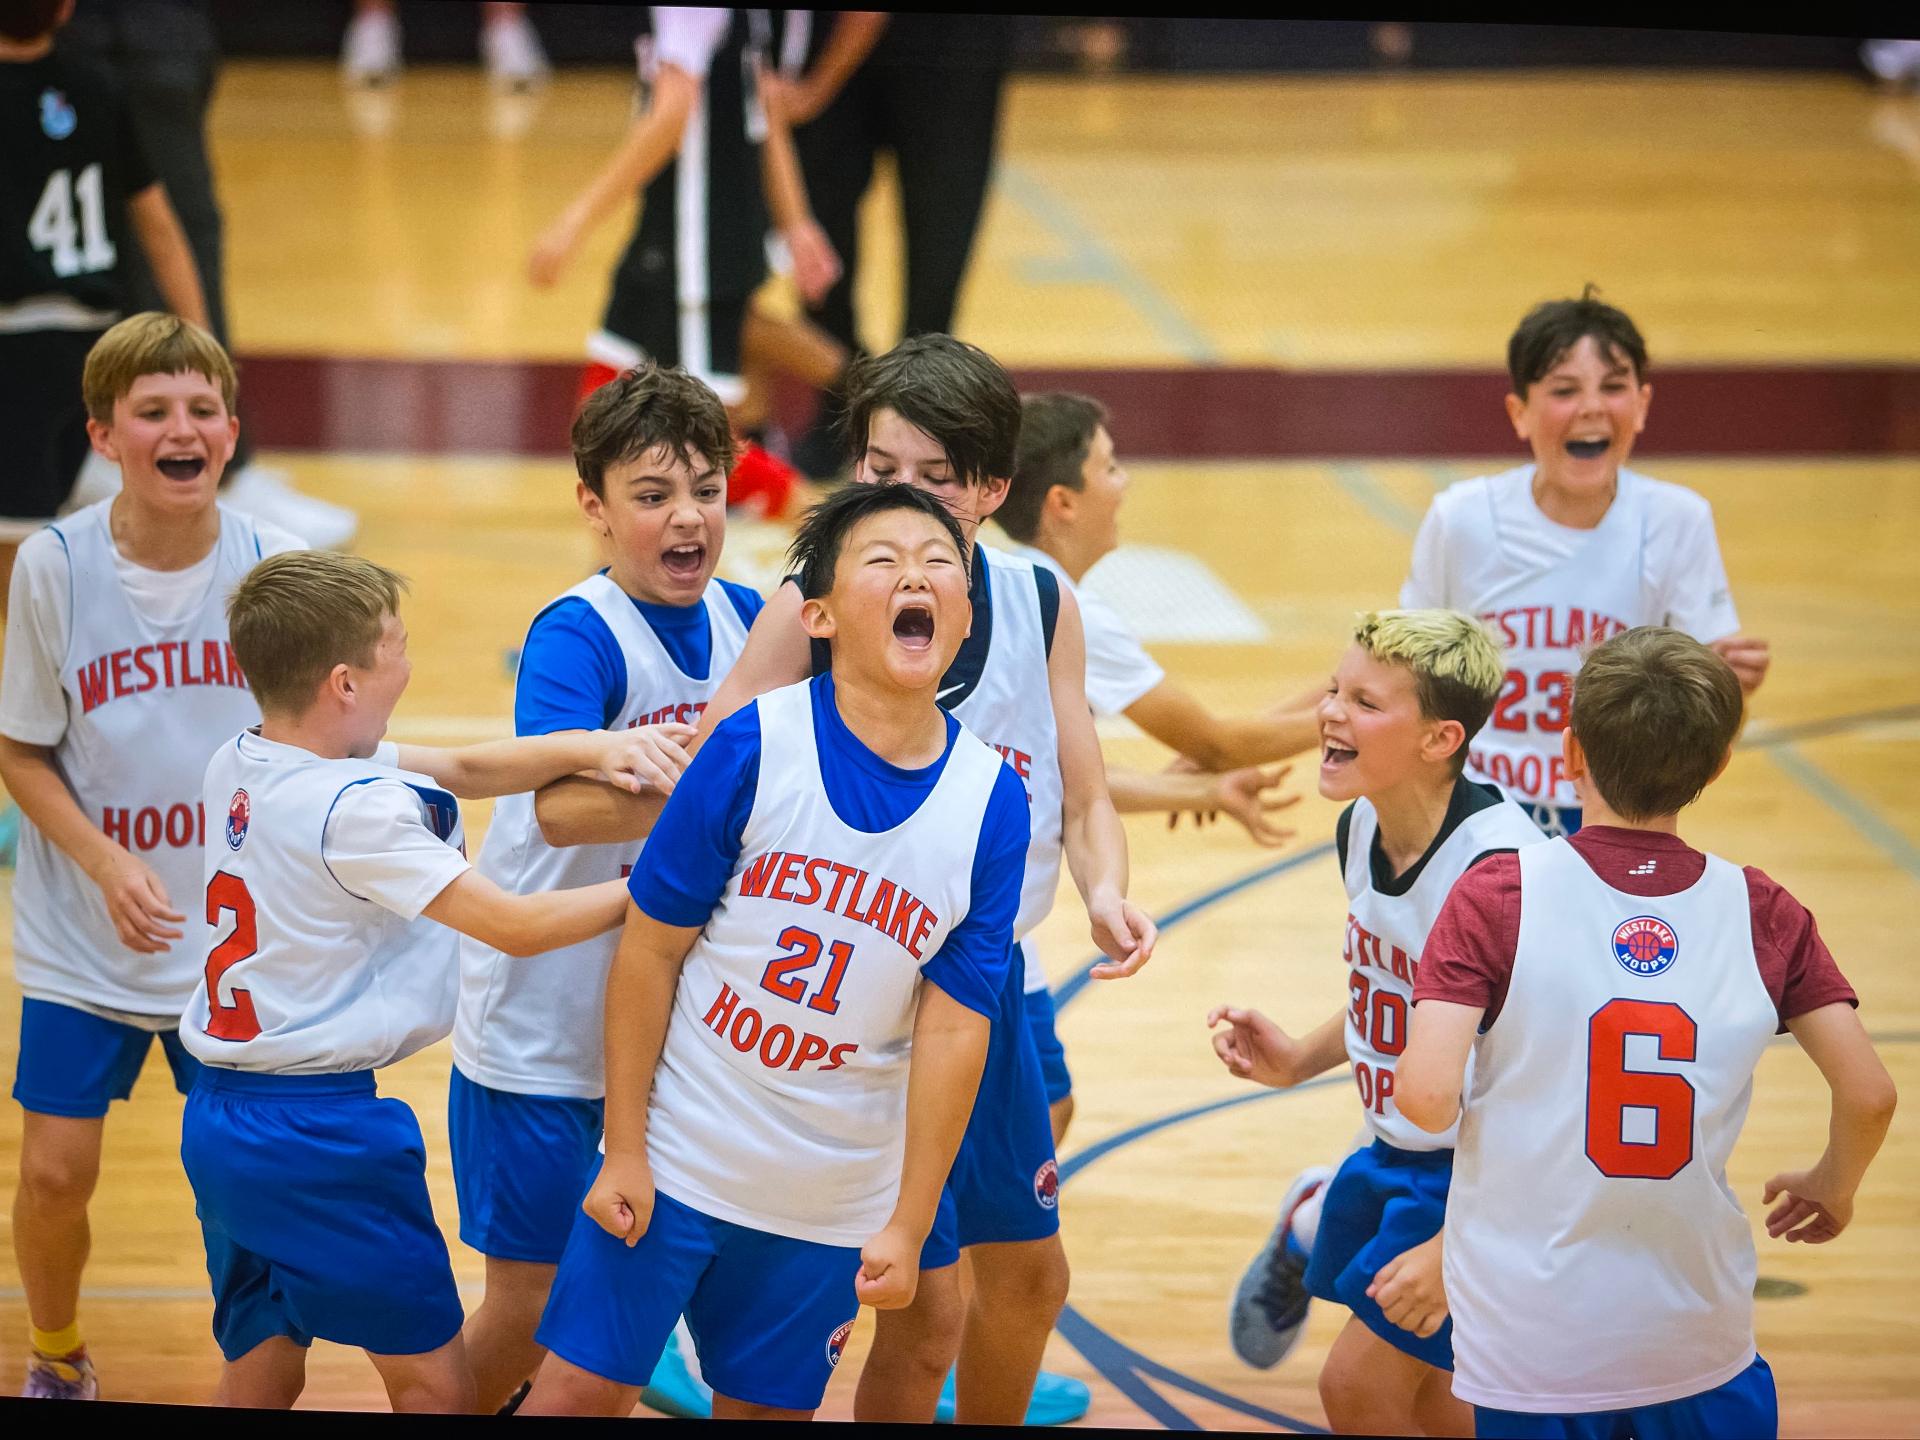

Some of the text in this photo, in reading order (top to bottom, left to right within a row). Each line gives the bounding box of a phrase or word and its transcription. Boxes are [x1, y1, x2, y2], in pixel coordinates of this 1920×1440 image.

[27, 163, 117, 278] 41
[77, 639, 248, 714] WESTLAK
[1493, 669, 1572, 733] 23
[103, 801, 206, 852] HOO
[739, 851, 938, 961] WESTLAKE
[1618, 921, 1672, 944] WESTLAKE
[203, 869, 263, 1042] 2
[759, 925, 855, 1016] 21
[1620, 952, 1668, 971] HOOPS
[701, 982, 859, 1072] HOOPS
[1348, 970, 1407, 1056] 30
[1585, 998, 1697, 1180] 6
